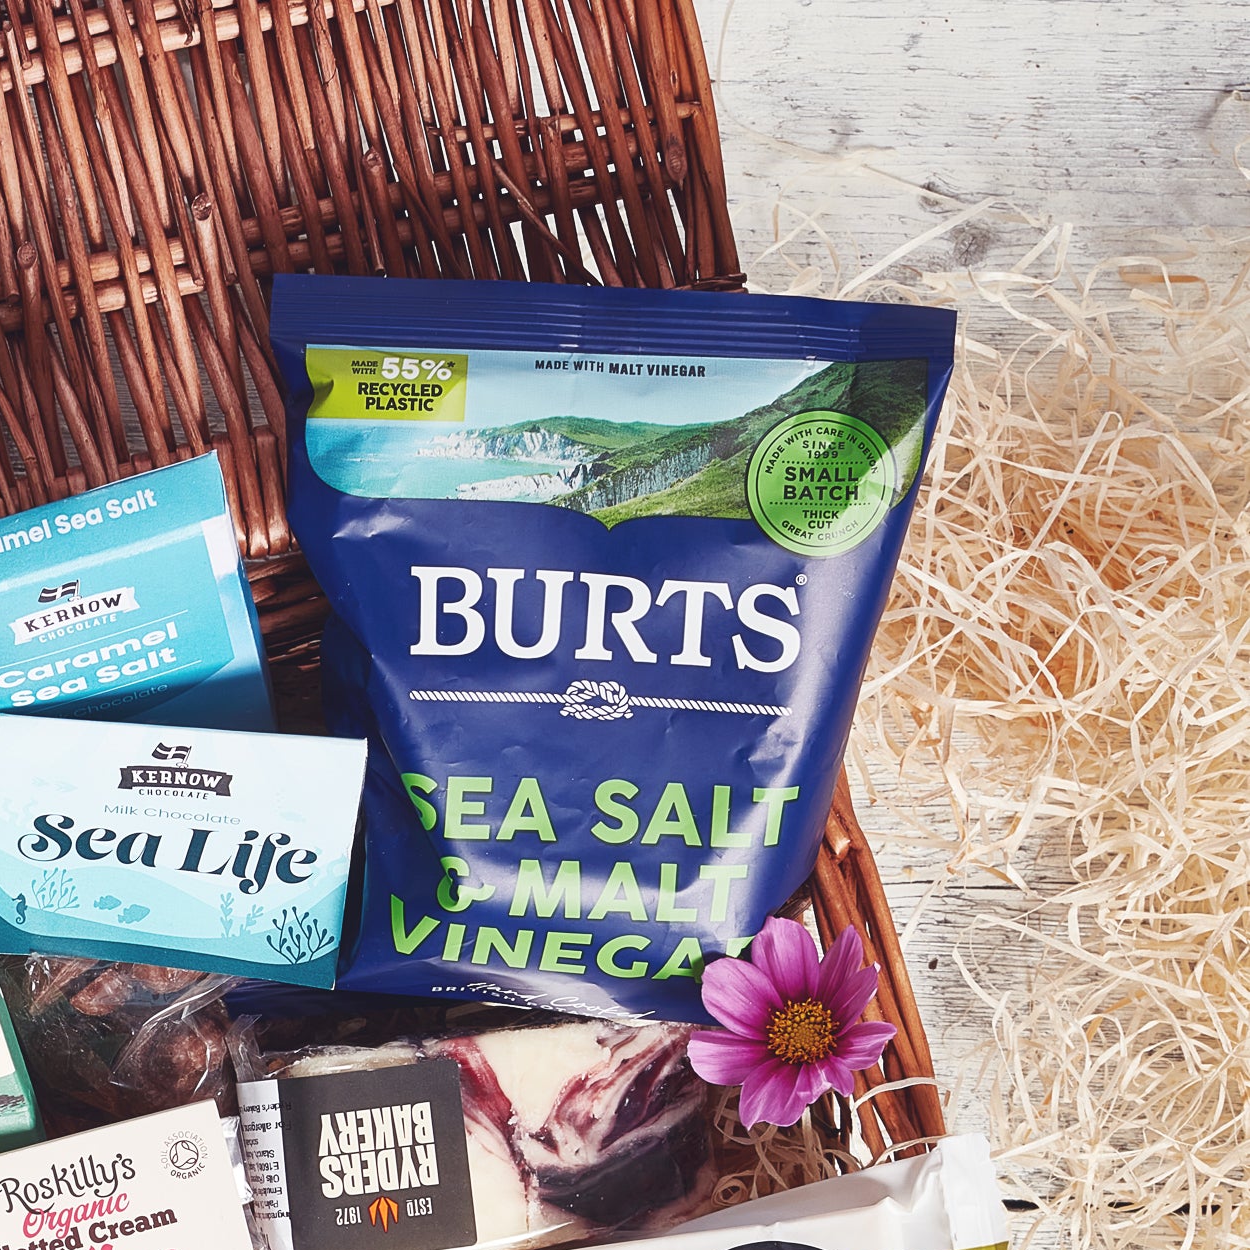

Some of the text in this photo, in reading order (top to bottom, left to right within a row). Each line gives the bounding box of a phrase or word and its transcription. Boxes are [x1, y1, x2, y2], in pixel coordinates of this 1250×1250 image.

[352, 367, 376, 375] WITH
[535, 360, 706, 378] MADE WITH MALT VINEGAR
[357, 382, 443, 397] RECYCLED
[365, 397, 434, 412] PLASTIC
[765, 427, 879, 474] MADE WITH CARE IN DEVON
[802, 440, 845, 450] SINCE
[807, 450, 839, 459] 1999
[784, 466, 859, 482] SMALL
[783, 485, 859, 501] BATCH
[56, 505, 104, 535] Sea
[106, 487, 158, 520] Salt
[802, 510, 839, 519] THICK
[782, 520, 859, 541] GREAT CRUNCH
[807, 520, 833, 529] CUT
[23, 593, 124, 634] KERNOW
[38, 614, 118, 644] CHOCOLATE
[10, 647, 178, 709] Sea Salt
[73, 683, 168, 718] Chocolate
[131, 769, 224, 789] KERNOW
[138, 787, 210, 801] CHOCOLATE
[104, 803, 241, 827] Milk Chocolate
[401, 773, 800, 849] SEA SALT
[17, 813, 318, 895] Sea Life
[508, 859, 748, 923] MALT
[318, 1102, 435, 1157] BAKERY
[170, 1162, 205, 1180] ORGANIC
[319, 1143, 440, 1199] RYDERS
[22, 1192, 130, 1239] Organic
[336, 1197, 433, 1226] ESTD 1972
[88, 1208, 178, 1244] Cream
